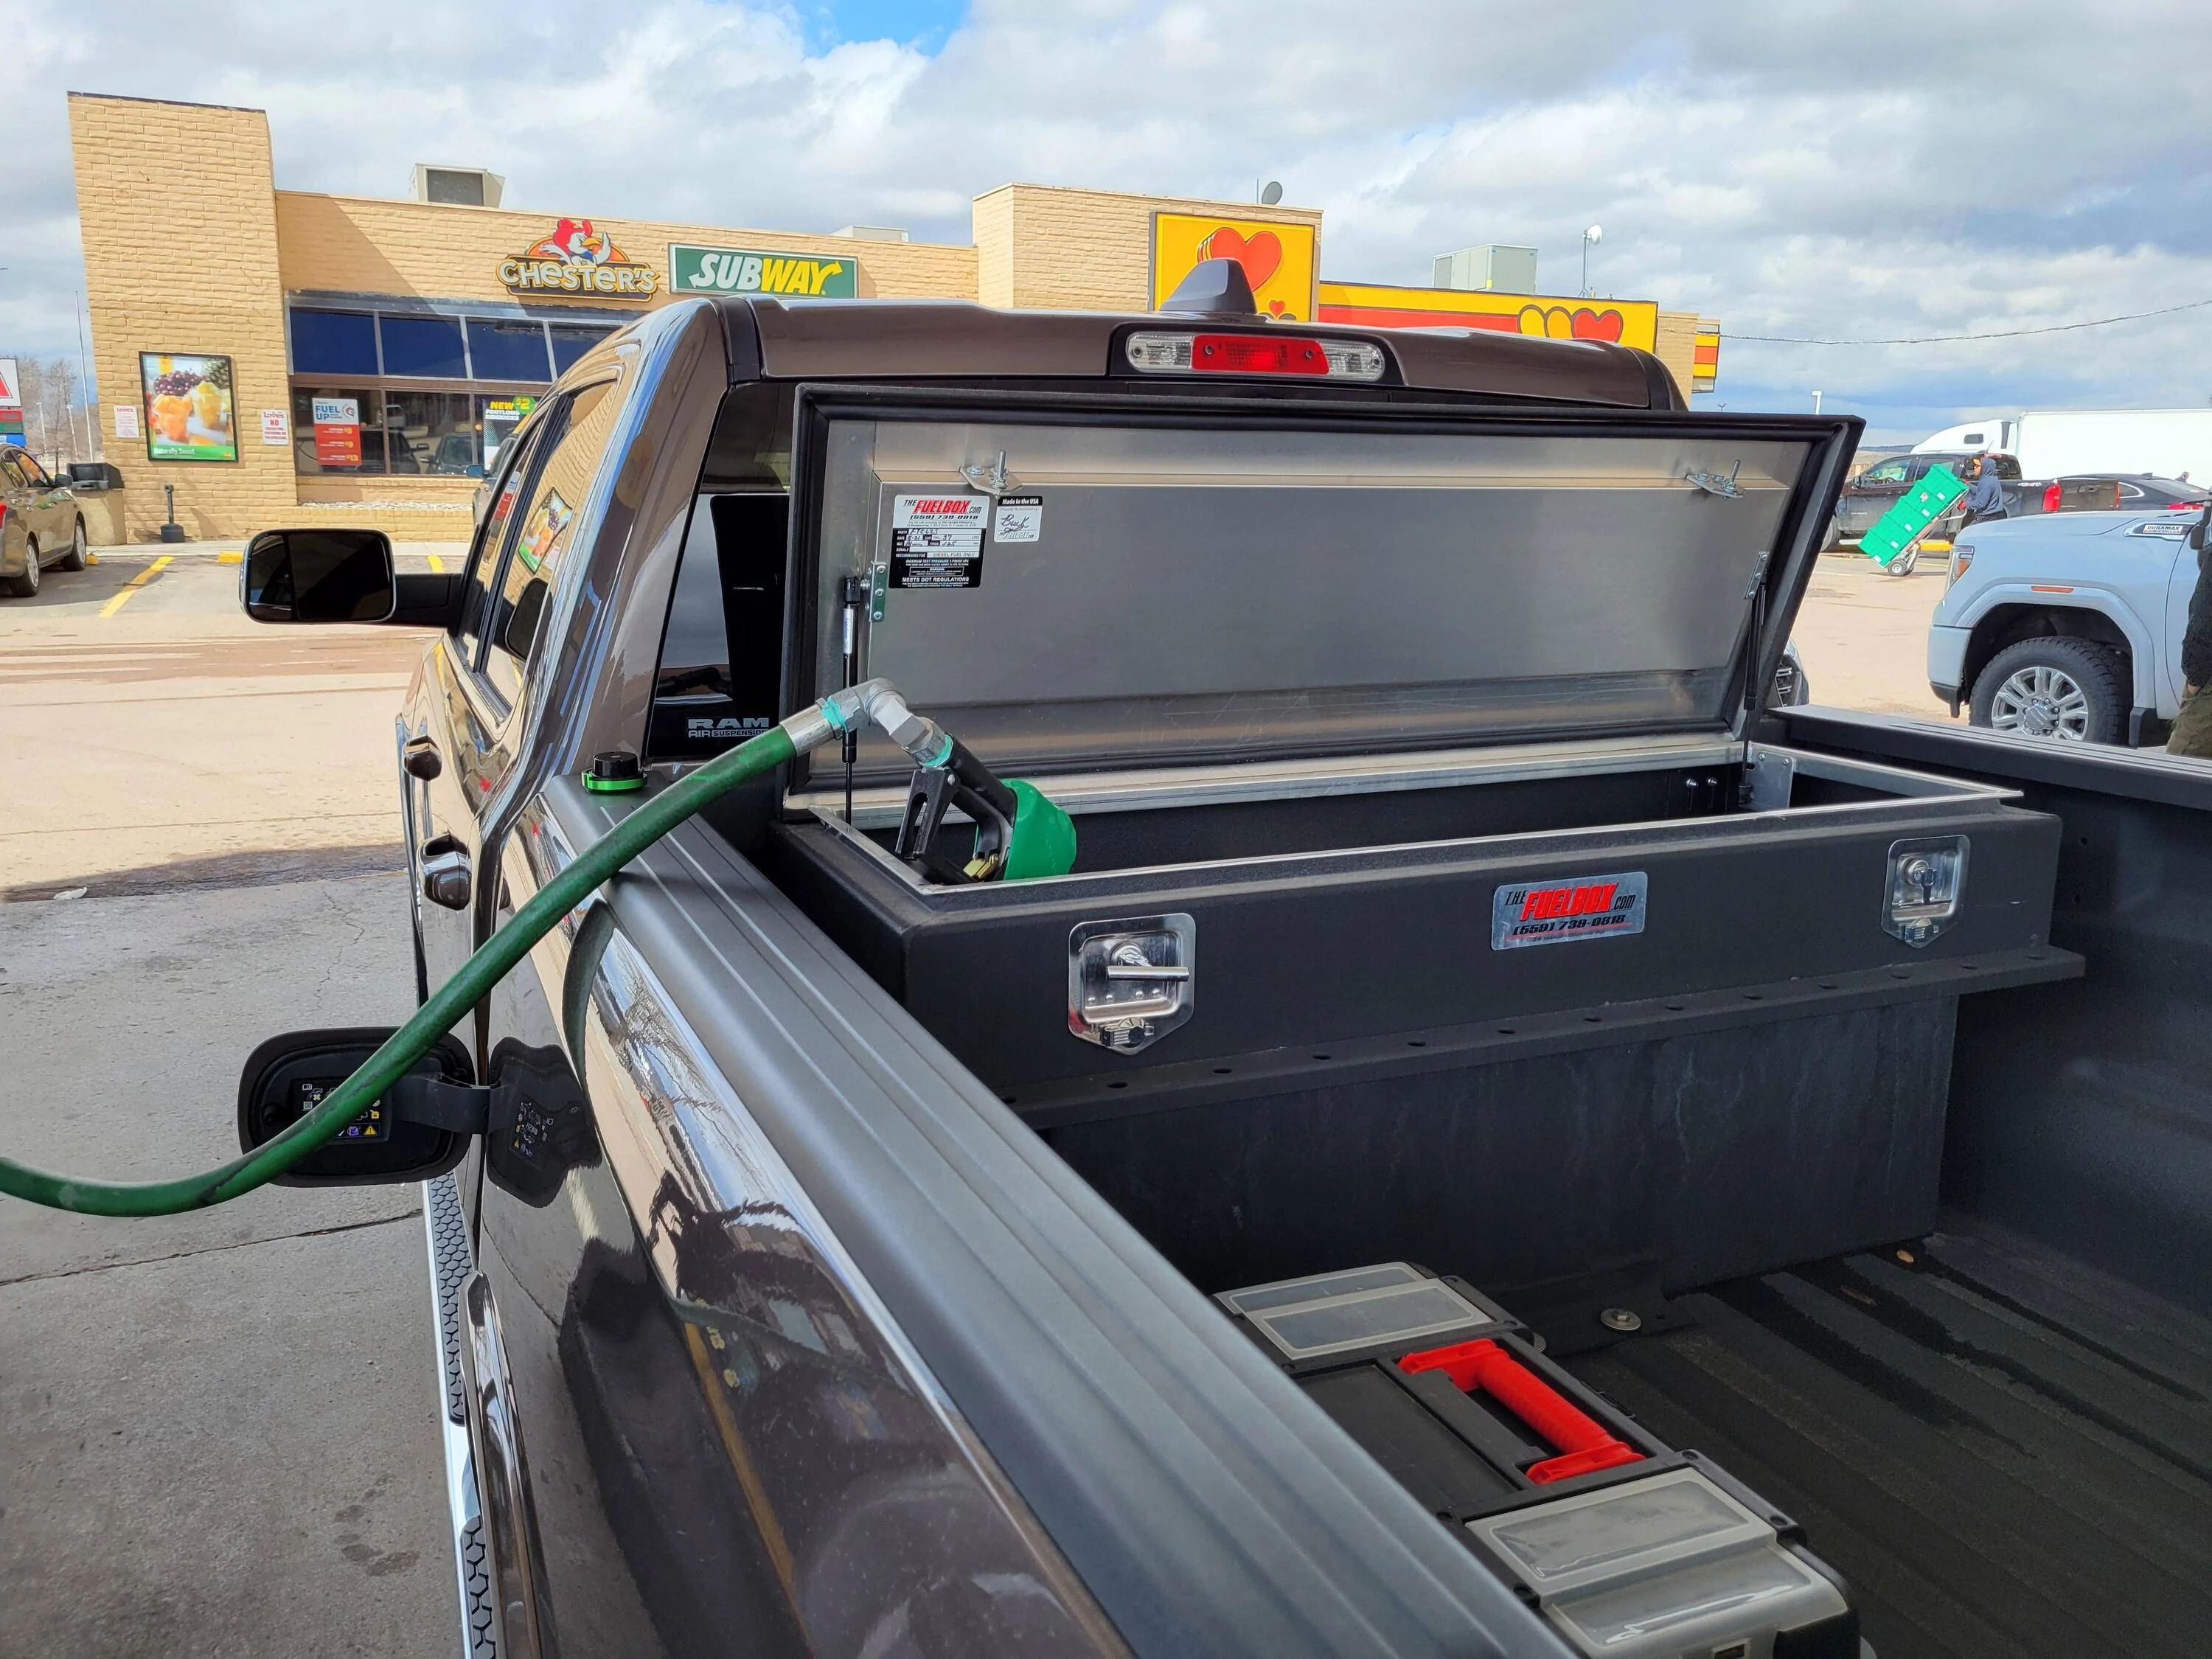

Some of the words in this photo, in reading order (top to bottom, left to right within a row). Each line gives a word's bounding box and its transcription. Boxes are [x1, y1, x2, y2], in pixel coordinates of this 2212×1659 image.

[688, 253, 843, 295] SUBWAY
[316, 405, 340, 414] FUEL
[490, 401, 514, 410] NEW
[913, 499, 972, 514] FUELBOX
[688, 717, 769, 728] RAM
[1504, 890, 1529, 906] THE
[1519, 883, 1618, 922] FUELBOX
